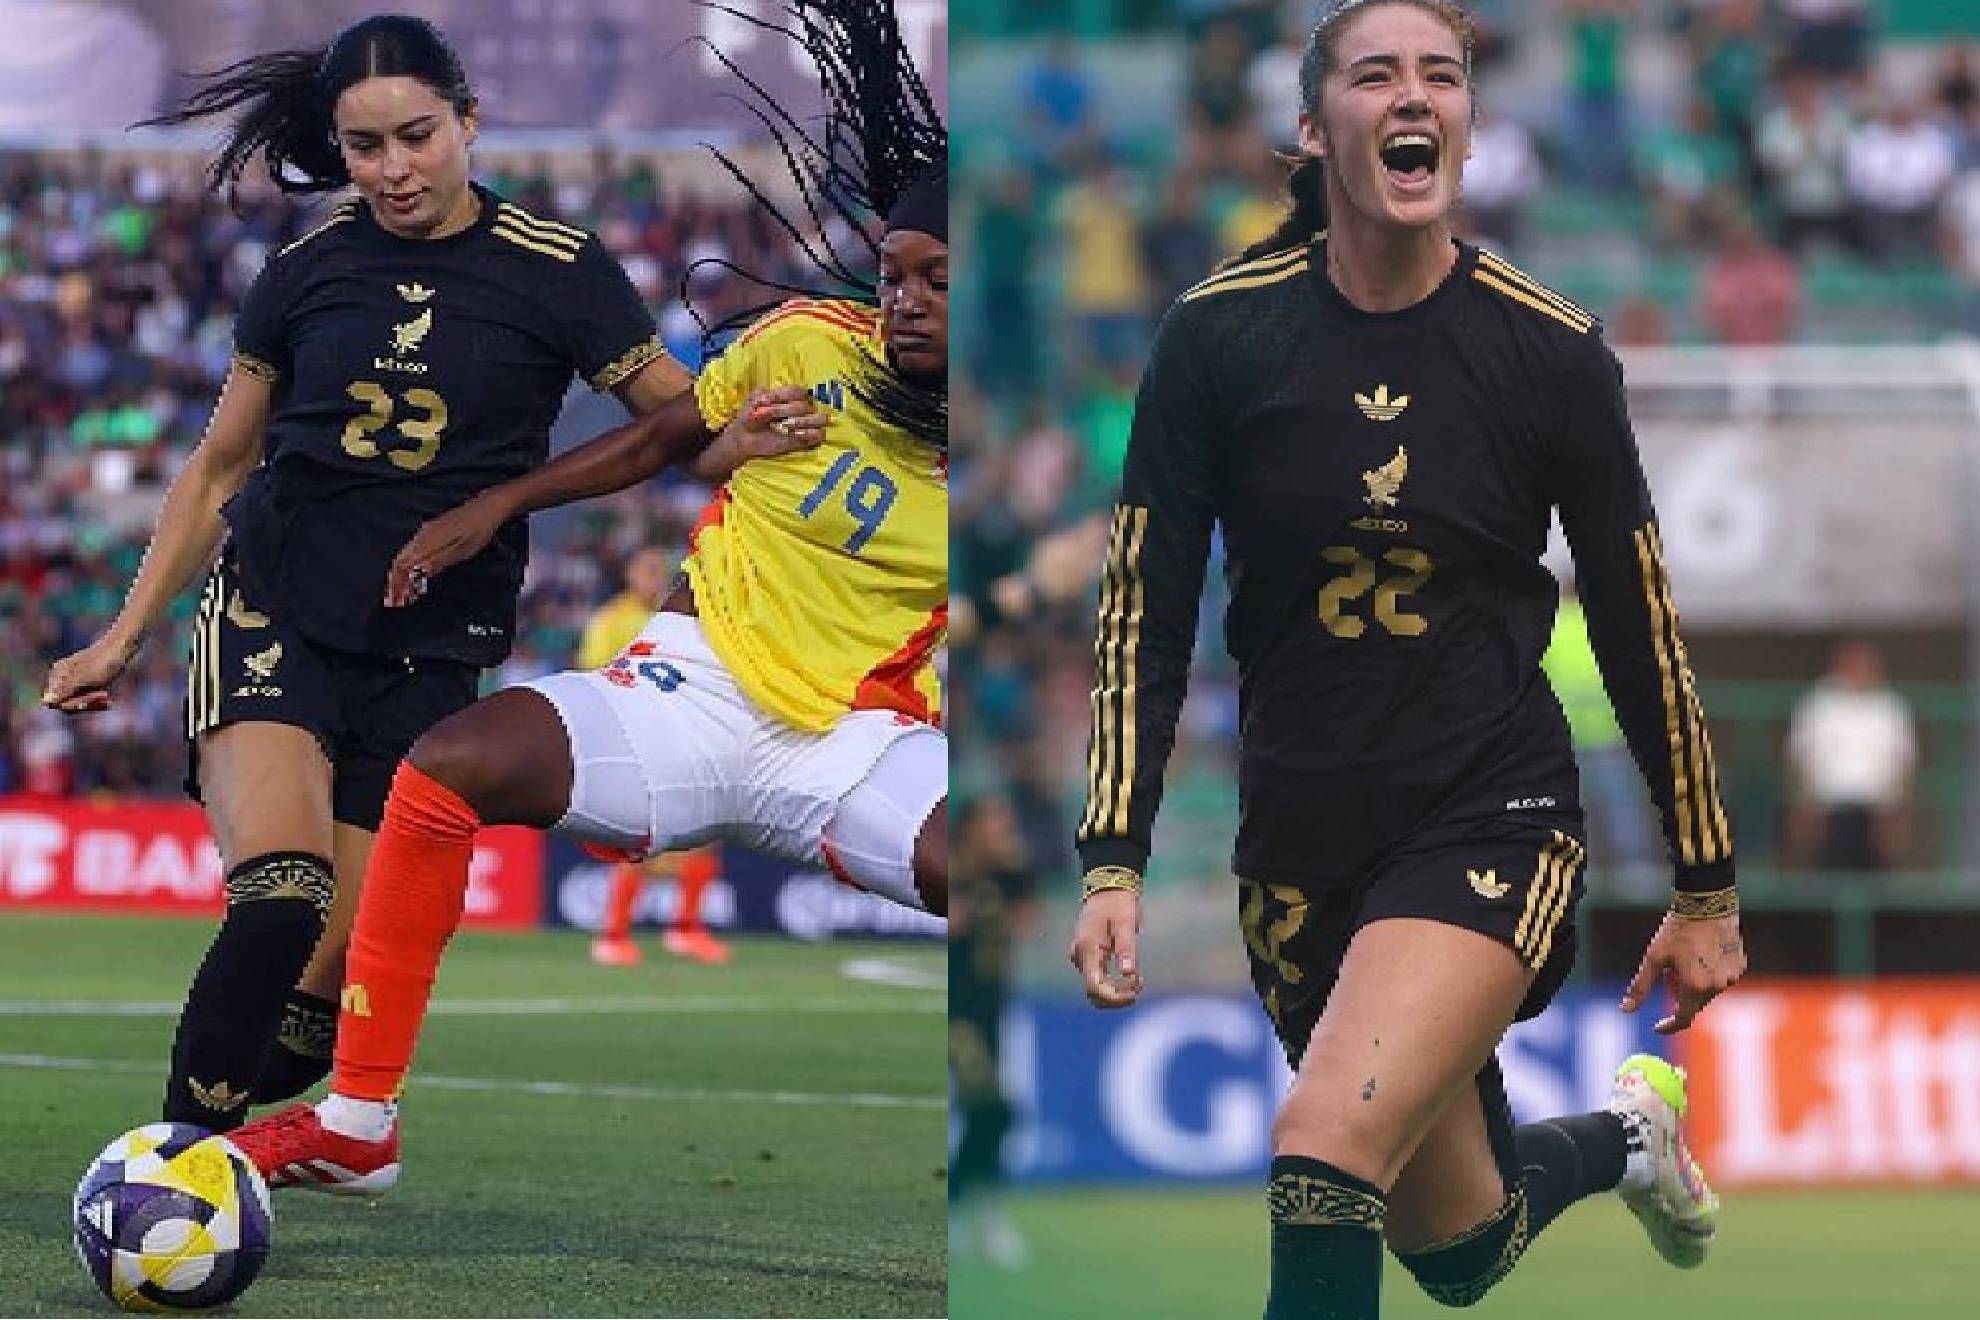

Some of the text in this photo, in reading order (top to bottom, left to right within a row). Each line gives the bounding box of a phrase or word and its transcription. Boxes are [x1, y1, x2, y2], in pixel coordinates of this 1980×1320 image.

[341, 381, 448, 471] 23
[796, 449, 898, 555] 19
[1317, 546, 1435, 638] 22
